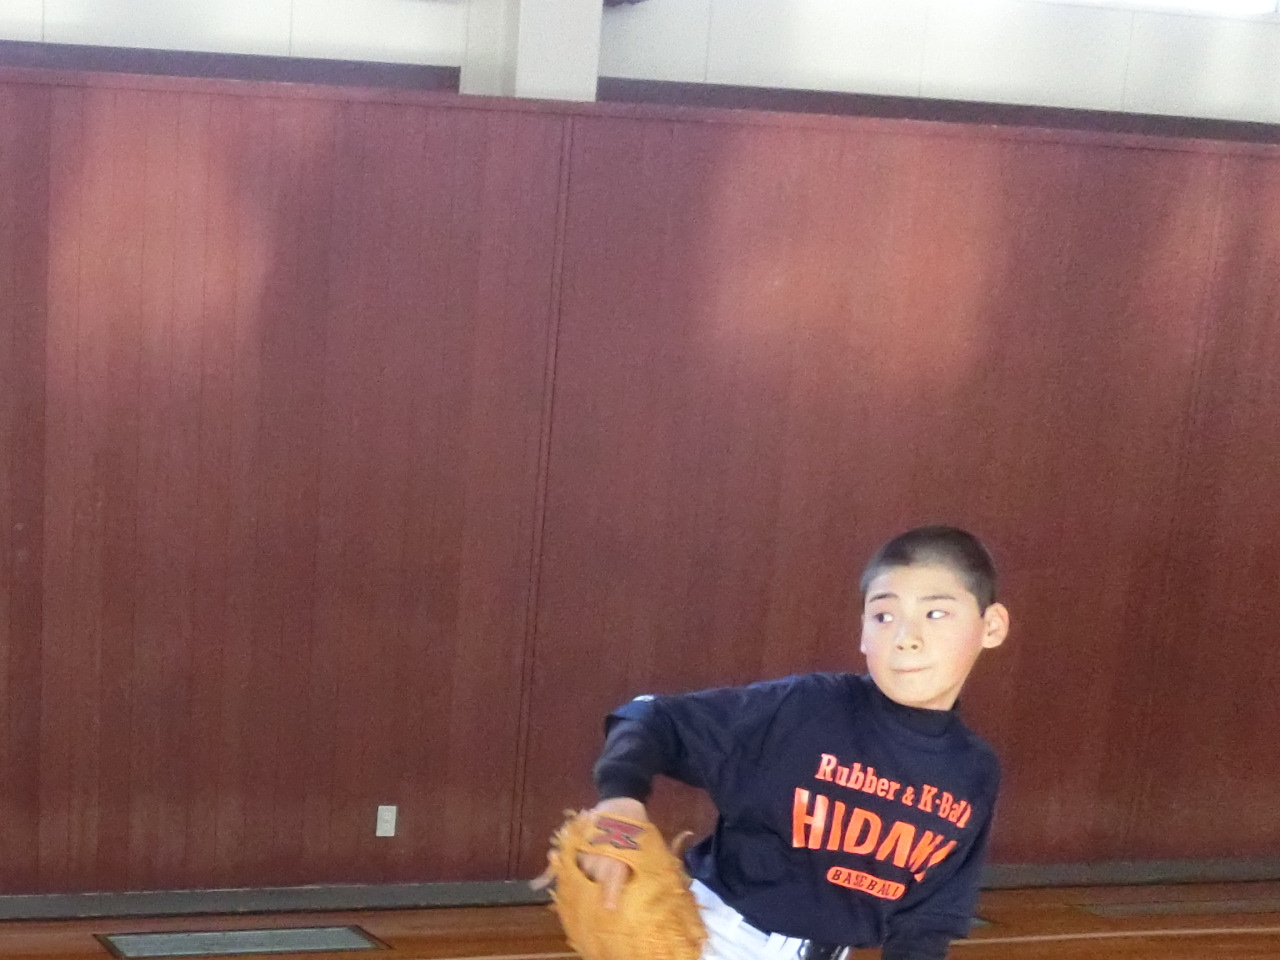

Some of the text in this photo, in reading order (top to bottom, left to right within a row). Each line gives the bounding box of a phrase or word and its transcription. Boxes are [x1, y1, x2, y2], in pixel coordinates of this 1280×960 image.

[815, 753, 901, 800] Rubber
[902, 786, 915, 806] &
[830, 868, 901, 898] BASEBALL
